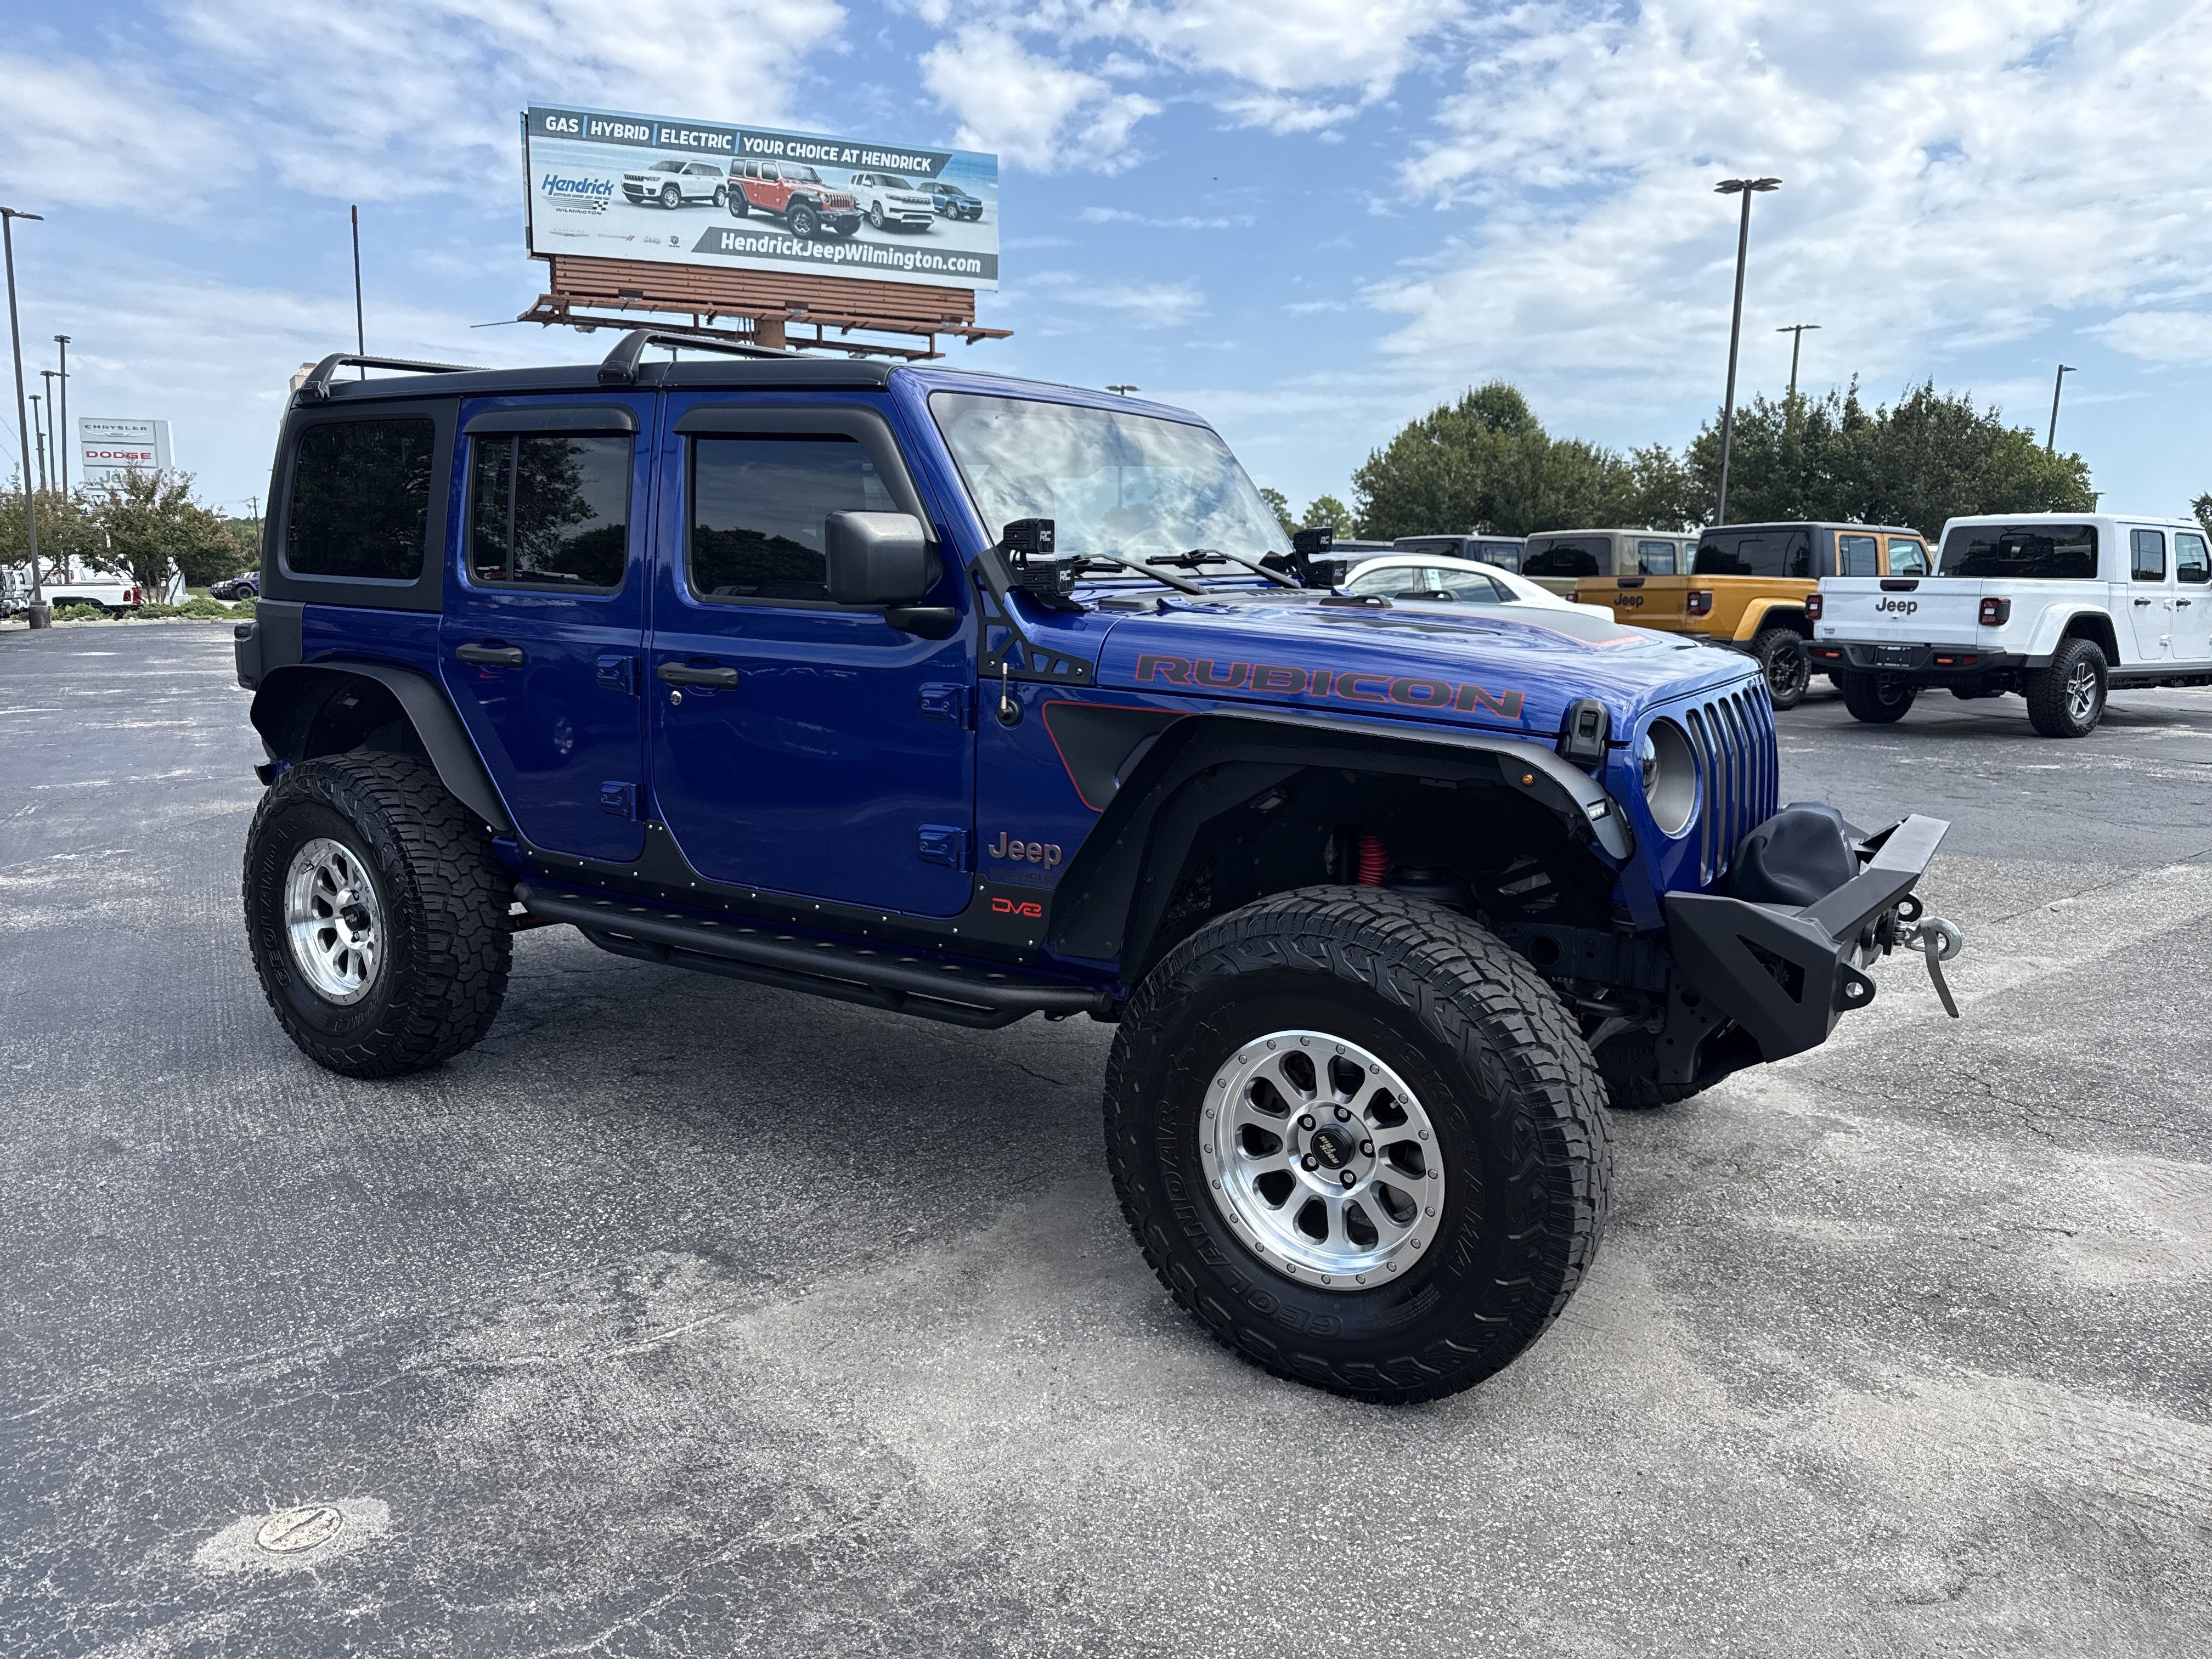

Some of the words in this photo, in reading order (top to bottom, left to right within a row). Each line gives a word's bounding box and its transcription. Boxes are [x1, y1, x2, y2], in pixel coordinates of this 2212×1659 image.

[545, 116, 579, 133] GAS
[590, 120, 650, 140] HYBRID
[661, 128, 732, 150] ELECTRIC
[743, 137, 784, 155] YOUR
[786, 142, 838, 161] CHOICE
[841, 149, 861, 163] AT
[861, 153, 932, 172] HENDRICK
[541, 174, 614, 195] Hendrick
[556, 207, 602, 216] WILMINGTON
[720, 232, 981, 273] HendrickJeepWilmington.com
[86, 450, 152, 460] DODGE
[1040, 531, 1052, 541] RC
[1320, 535, 1330, 545] RC
[1059, 569, 1071, 582] RC
[1334, 568, 1344, 578] RC
[1614, 593, 1644, 608] Jeep
[1875, 597, 1918, 616] Jeep
[1135, 653, 1526, 719] RUBICON
[988, 832, 1063, 871] Jeep
[1319, 1144, 1340, 1164] ROCK
